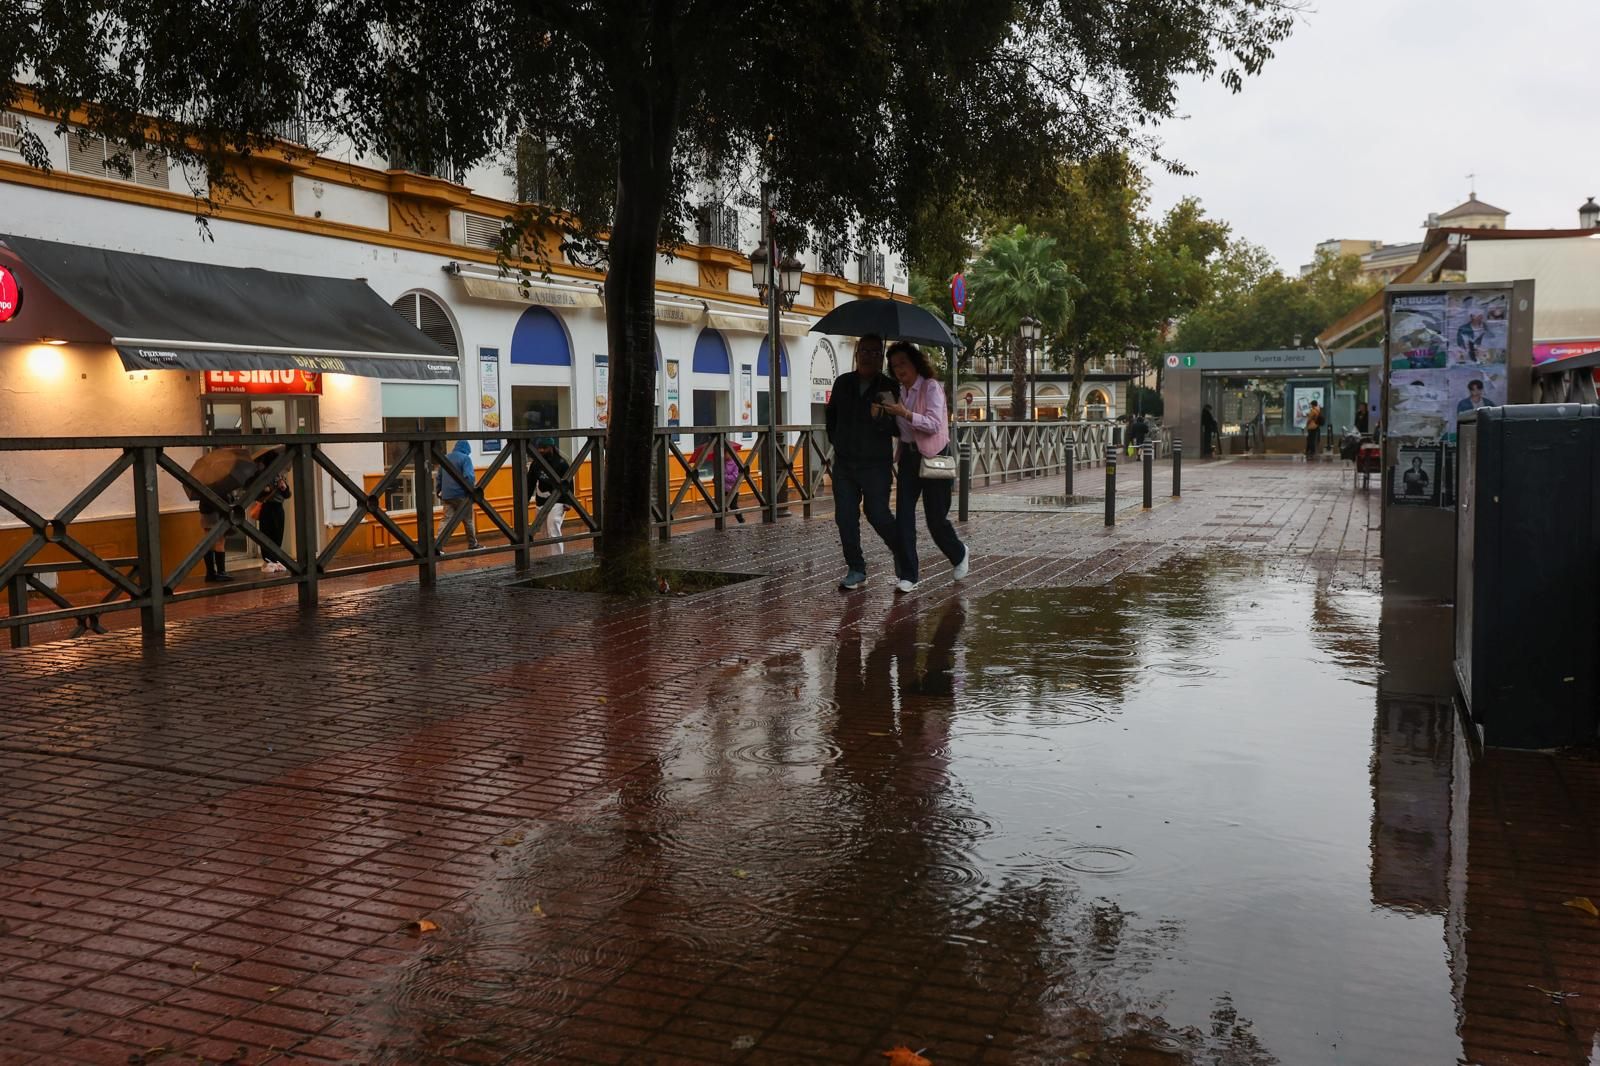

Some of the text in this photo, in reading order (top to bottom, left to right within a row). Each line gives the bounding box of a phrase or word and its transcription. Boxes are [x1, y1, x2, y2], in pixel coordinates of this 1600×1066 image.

[139, 350, 177, 360] Cruzcampo
[1254, 355, 1282, 363] Puerta
[1284, 354, 1305, 362] Jerez
[210, 369, 235, 382] EL
[239, 369, 295, 384] SIRIO
